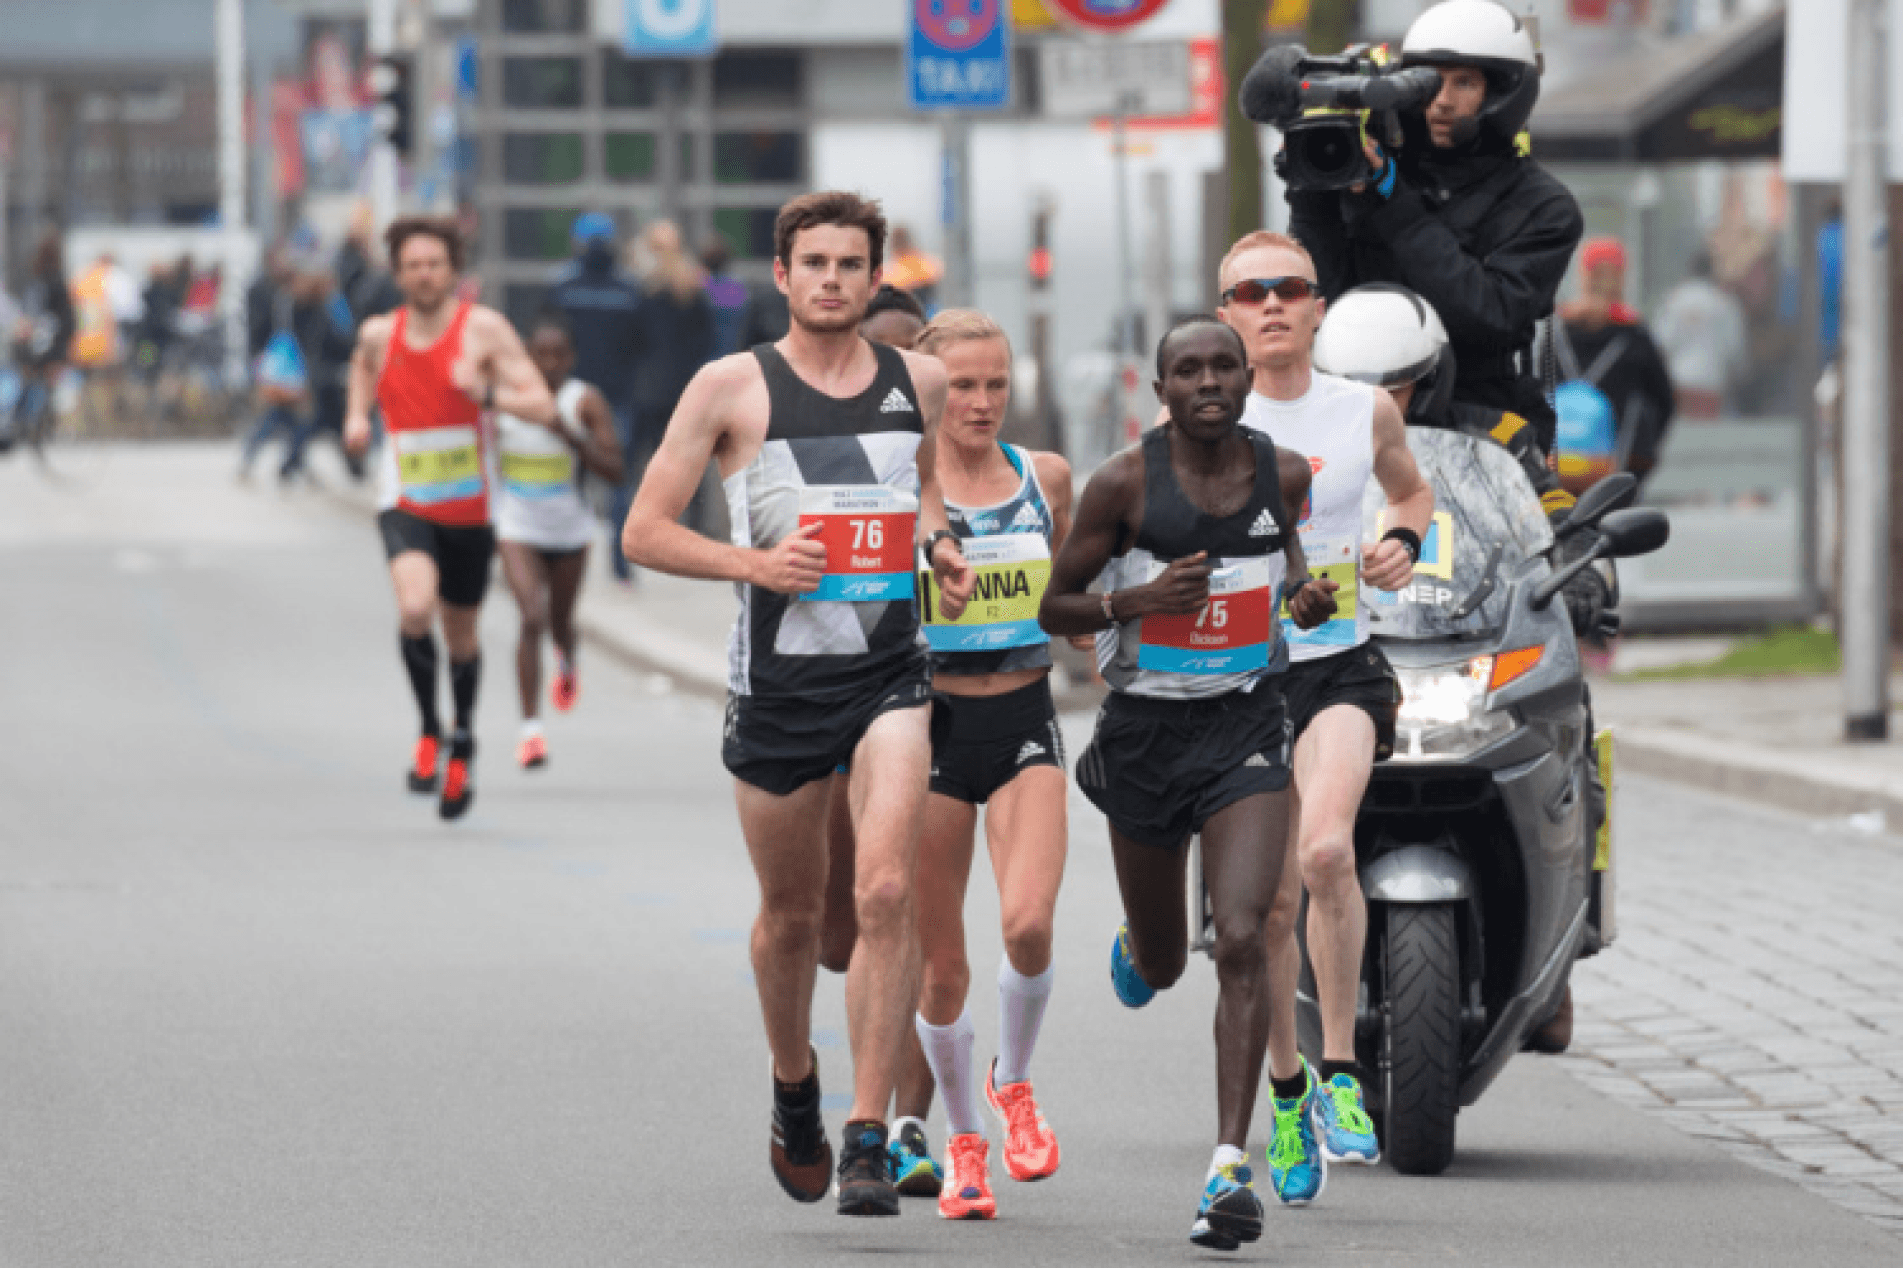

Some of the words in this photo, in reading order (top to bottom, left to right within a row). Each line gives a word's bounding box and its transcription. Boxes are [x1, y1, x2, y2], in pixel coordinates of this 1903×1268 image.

[917, 58, 1002, 92] TAXI
[849, 519, 884, 550] 76
[850, 555, 882, 569] Robert
[968, 570, 1031, 601] NNA
[1397, 583, 1453, 607] NEP
